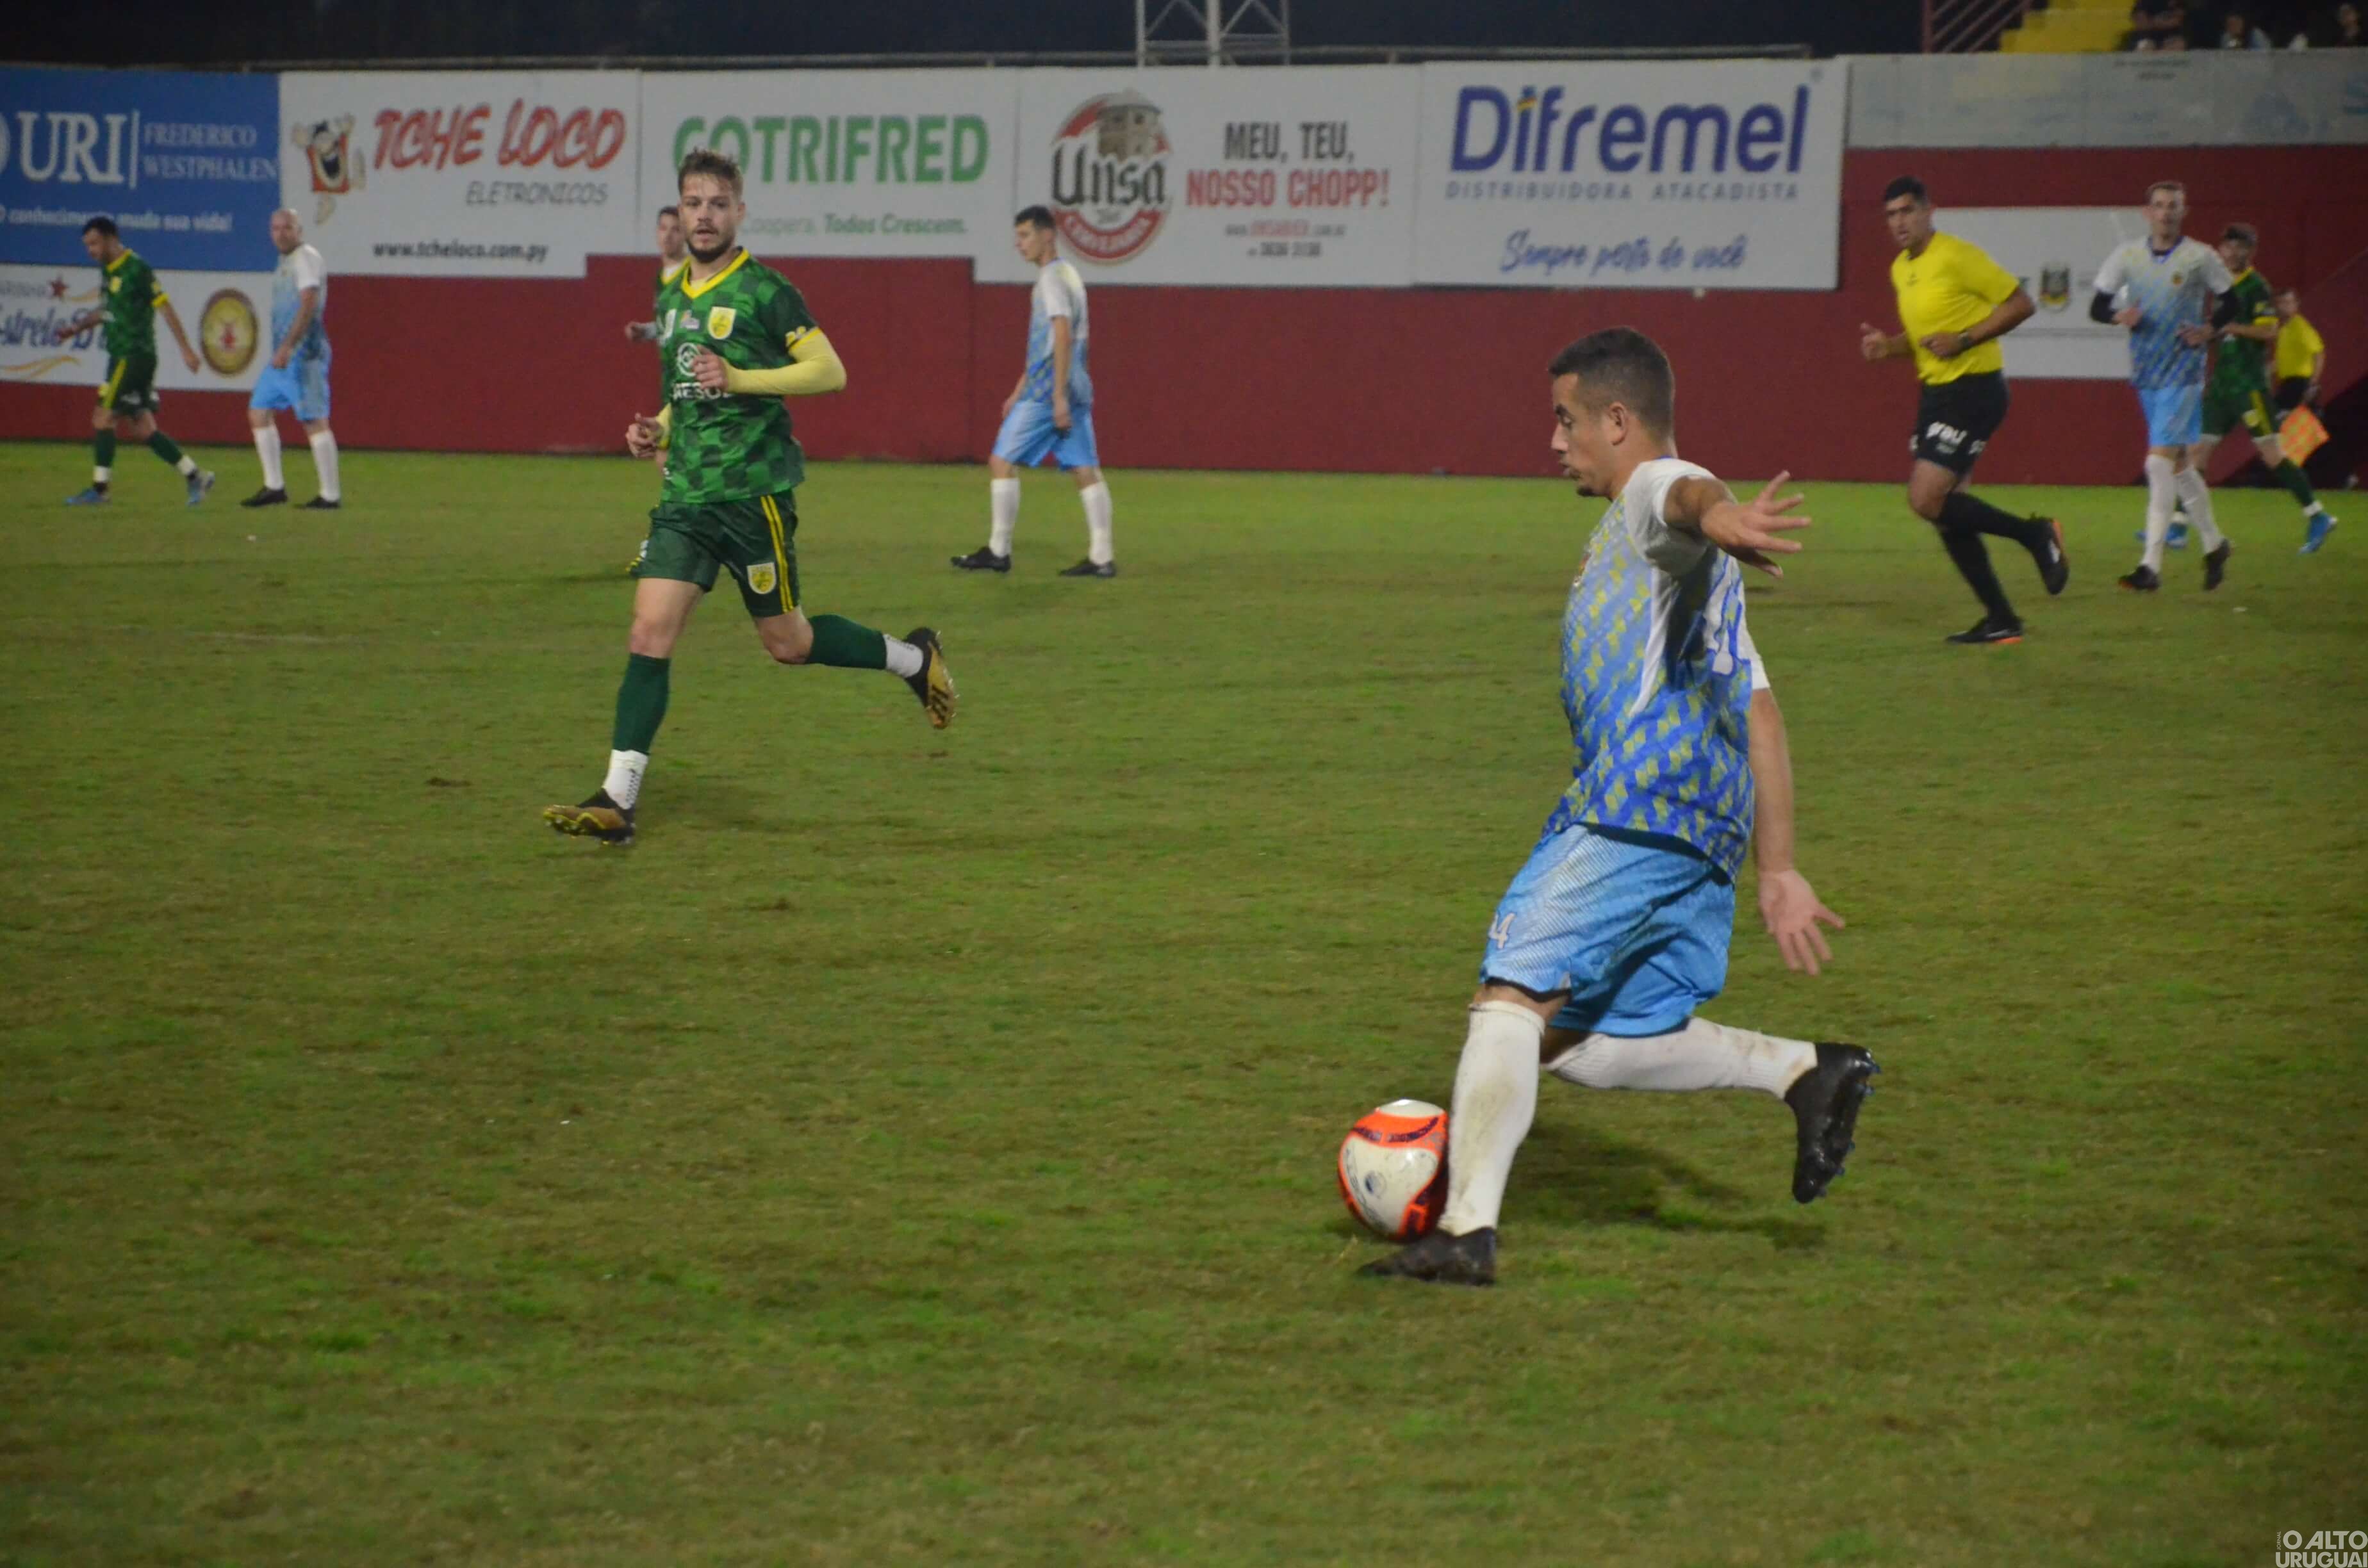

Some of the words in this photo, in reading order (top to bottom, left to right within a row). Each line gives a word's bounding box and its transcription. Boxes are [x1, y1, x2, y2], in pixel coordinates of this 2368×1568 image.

[15, 111, 128, 184] URI
[144, 123, 258, 148] FREDERICO
[374, 104, 491, 170] TCHE
[497, 98, 626, 170] LOCO
[1224, 122, 1287, 163] MEU,
[1299, 121, 1355, 162] TEU,
[1451, 84, 1810, 173] Difremel
[144, 154, 279, 180] WESTPHALEN
[673, 115, 990, 183] COTRIFRED
[466, 181, 608, 206] ELETRONICOS
[1186, 169, 1276, 207] NOSSO
[1287, 168, 1389, 208] CHOPP!
[1445, 181, 1632, 200] DISTRIBUIDORA
[1652, 182, 1798, 200] ATACADISTA
[825, 213, 875, 234] Todos
